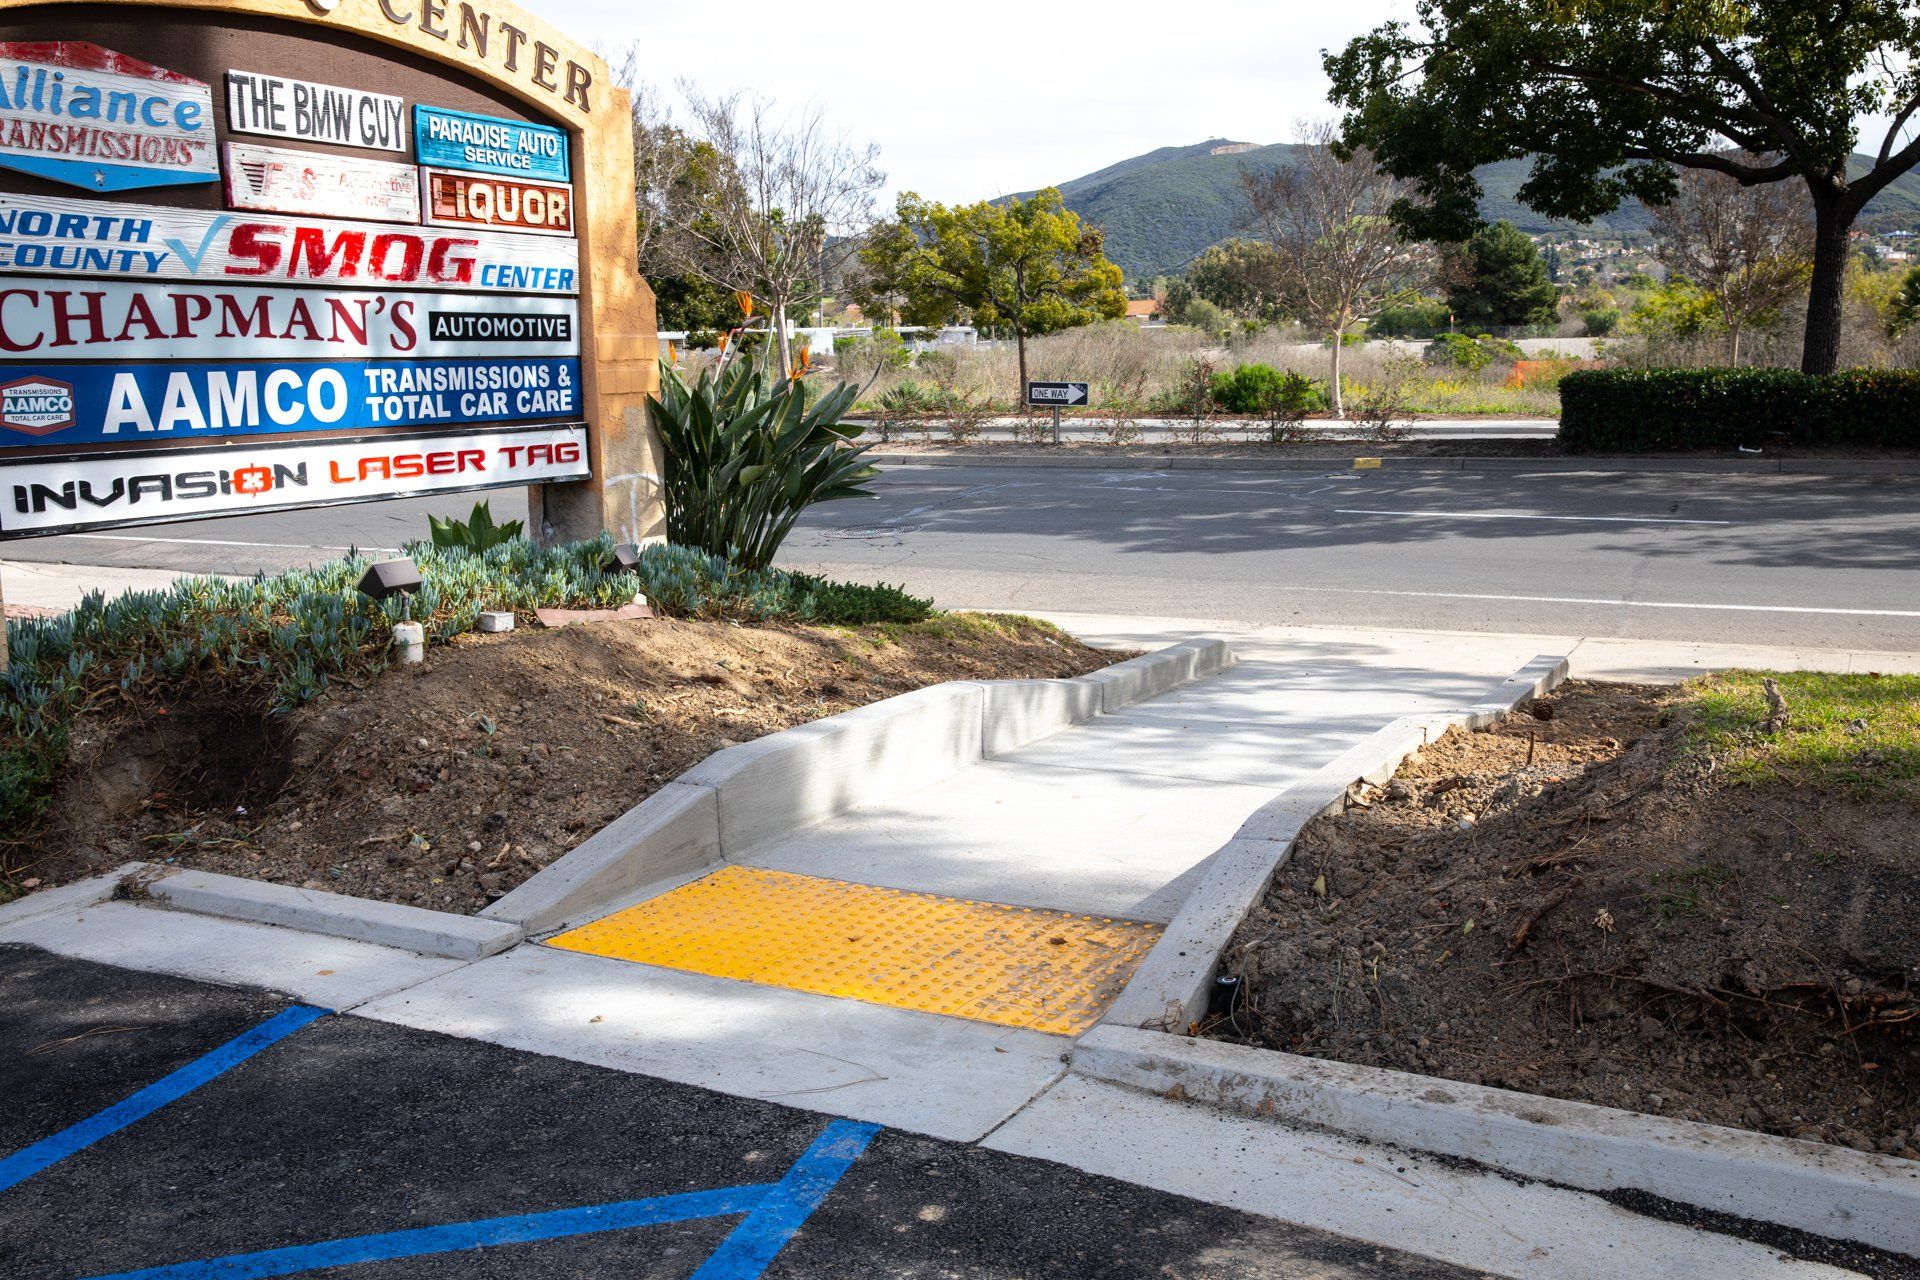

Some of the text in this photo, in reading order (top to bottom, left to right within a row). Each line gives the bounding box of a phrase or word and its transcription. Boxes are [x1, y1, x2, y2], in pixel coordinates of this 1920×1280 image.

[229, 74, 403, 149] THE BMW GUY
[428, 115, 558, 157] PARADISE AUTO
[464, 146, 531, 170] SERVICE
[433, 177, 567, 226] LIQUOR
[225, 222, 479, 285] SMOG
[480, 264, 574, 291] CENTER
[0, 288, 418, 353] CHAPMAN'S
[434, 315, 568, 338] AUTOMOTIVE
[364, 364, 572, 395] TRANSMISSIONS &
[1033, 388, 1068, 399] ONE WAY
[1, 396, 73, 413] AAMCO
[102, 367, 349, 434] AAMCO
[365, 389, 573, 422] TOTAL CAR CARE
[329, 442, 579, 483] LASER TAG
[13, 462, 308, 514] INVASION
